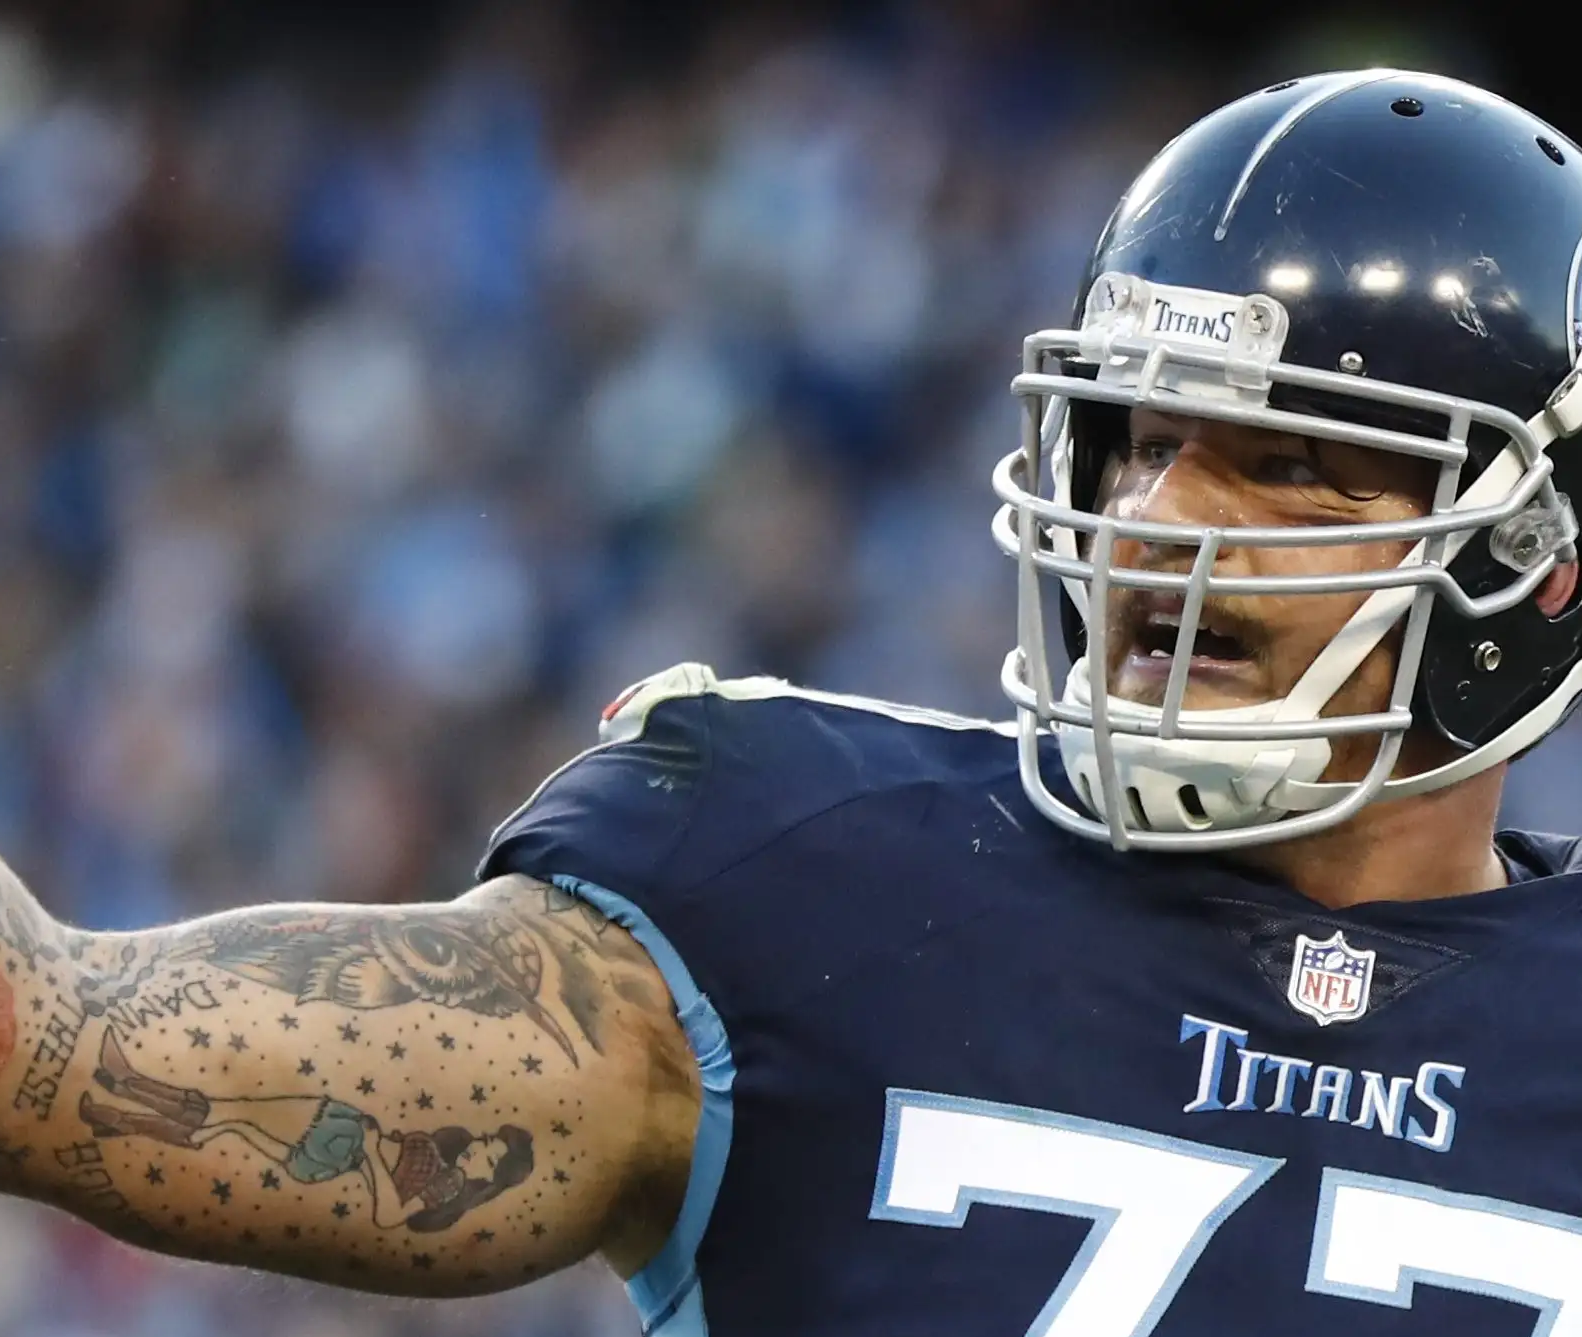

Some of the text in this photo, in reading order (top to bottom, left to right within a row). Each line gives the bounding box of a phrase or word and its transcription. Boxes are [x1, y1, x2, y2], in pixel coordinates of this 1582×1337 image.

[1155, 298, 1236, 344] TITANS
[107, 980, 222, 1043] DAMN
[1304, 969, 1356, 1010] NFL
[1178, 1012, 1467, 1153] TITANS
